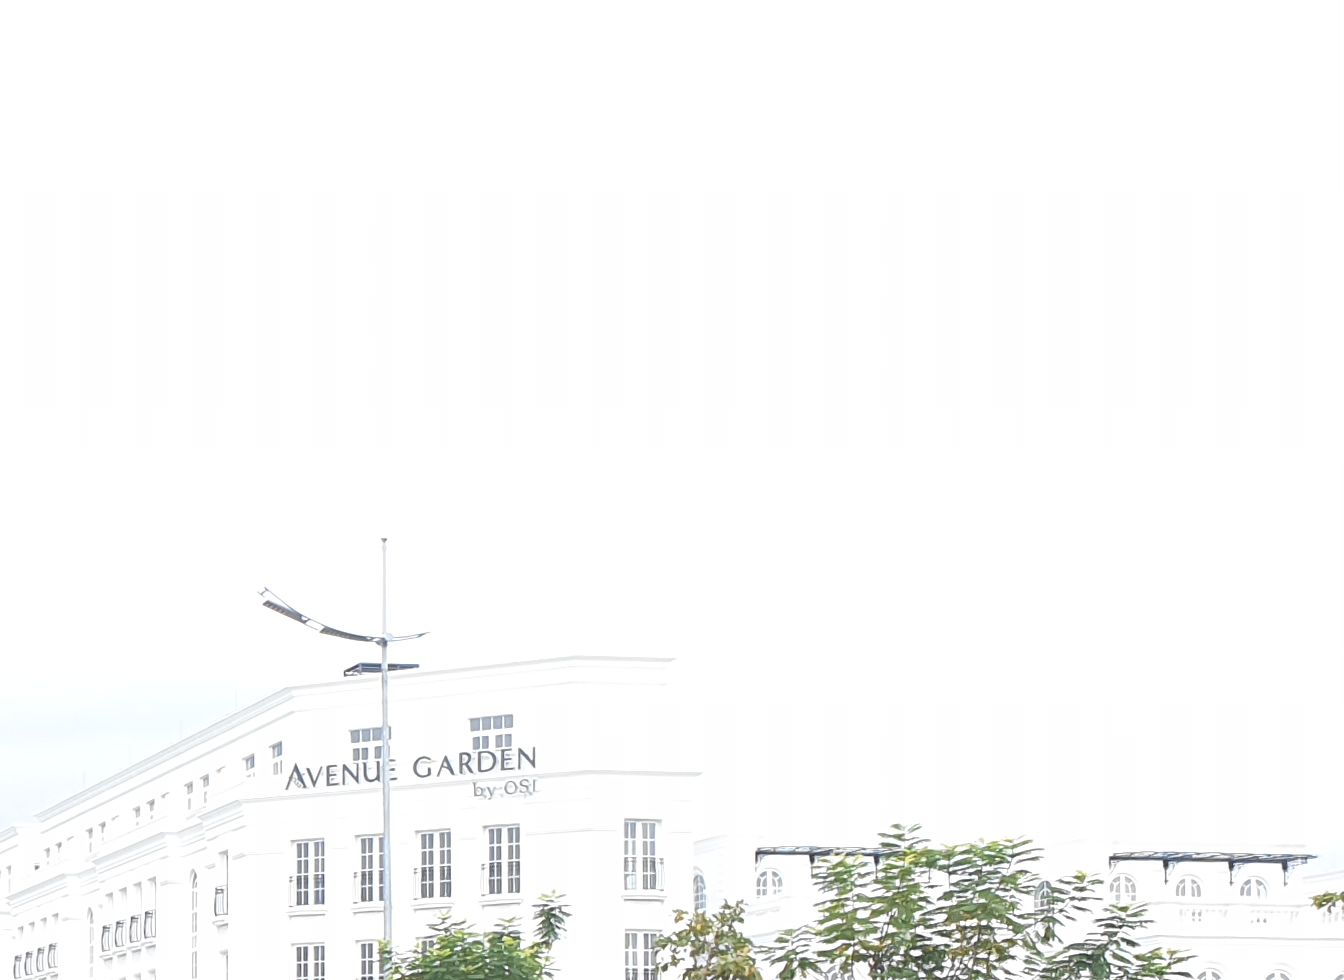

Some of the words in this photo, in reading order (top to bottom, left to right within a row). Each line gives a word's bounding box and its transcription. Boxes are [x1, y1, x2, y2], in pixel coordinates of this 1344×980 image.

[285, 759, 398, 791] AVENUE
[412, 746, 536, 778] GARDEN
[472, 781, 496, 800] by
[503, 778, 537, 796] OSI
